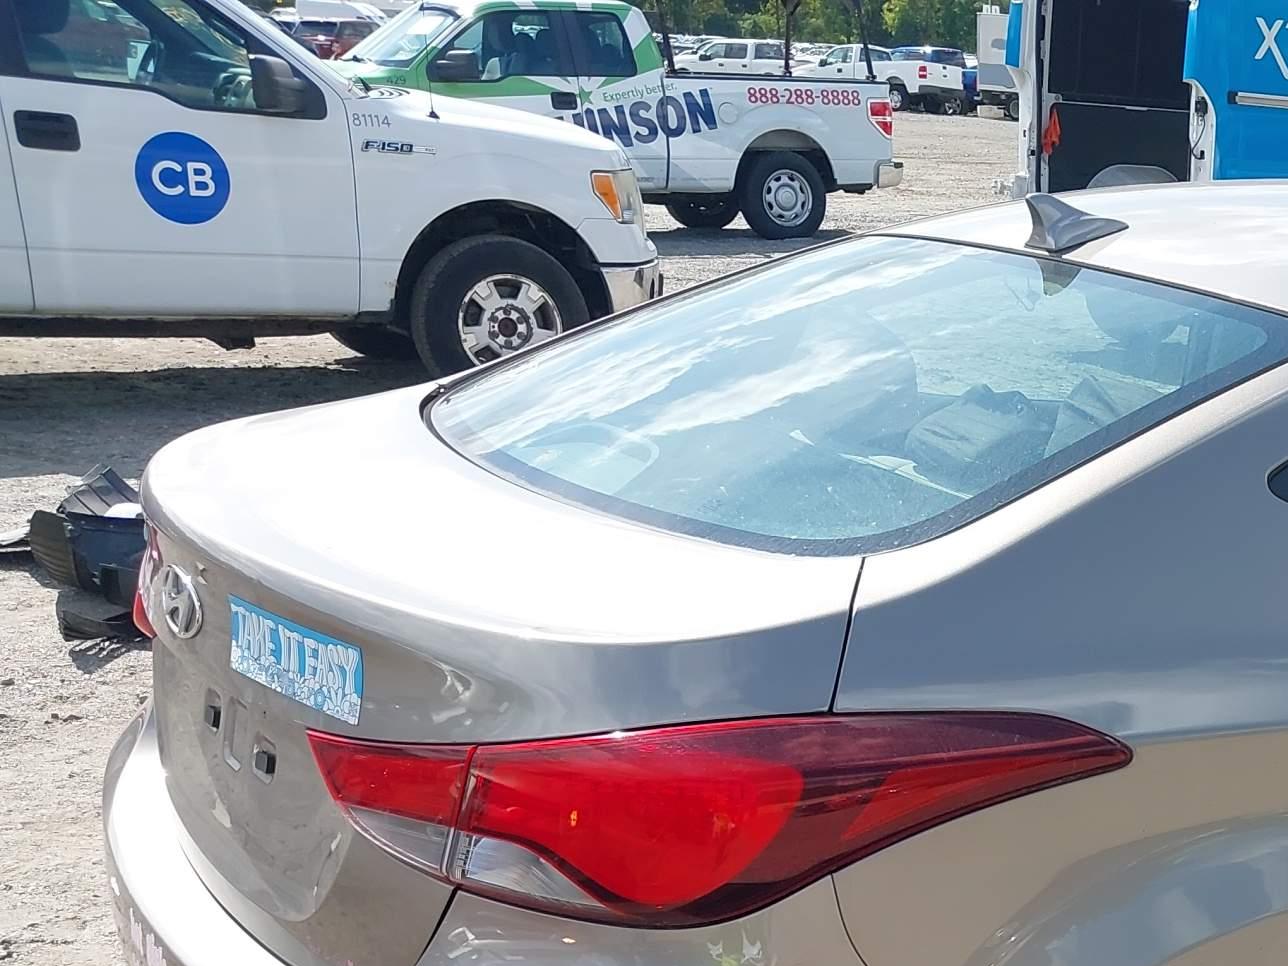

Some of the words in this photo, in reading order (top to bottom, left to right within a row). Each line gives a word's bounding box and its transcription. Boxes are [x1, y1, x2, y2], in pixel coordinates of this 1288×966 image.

[602, 85, 644, 102] Expertly
[747, 86, 861, 106] 888-288-8888
[352, 112, 391, 128] 81114
[151, 160, 216, 197] CB
[230, 603, 276, 661] TAKE
[278, 623, 304, 674] IT
[303, 637, 360, 696] EASY
